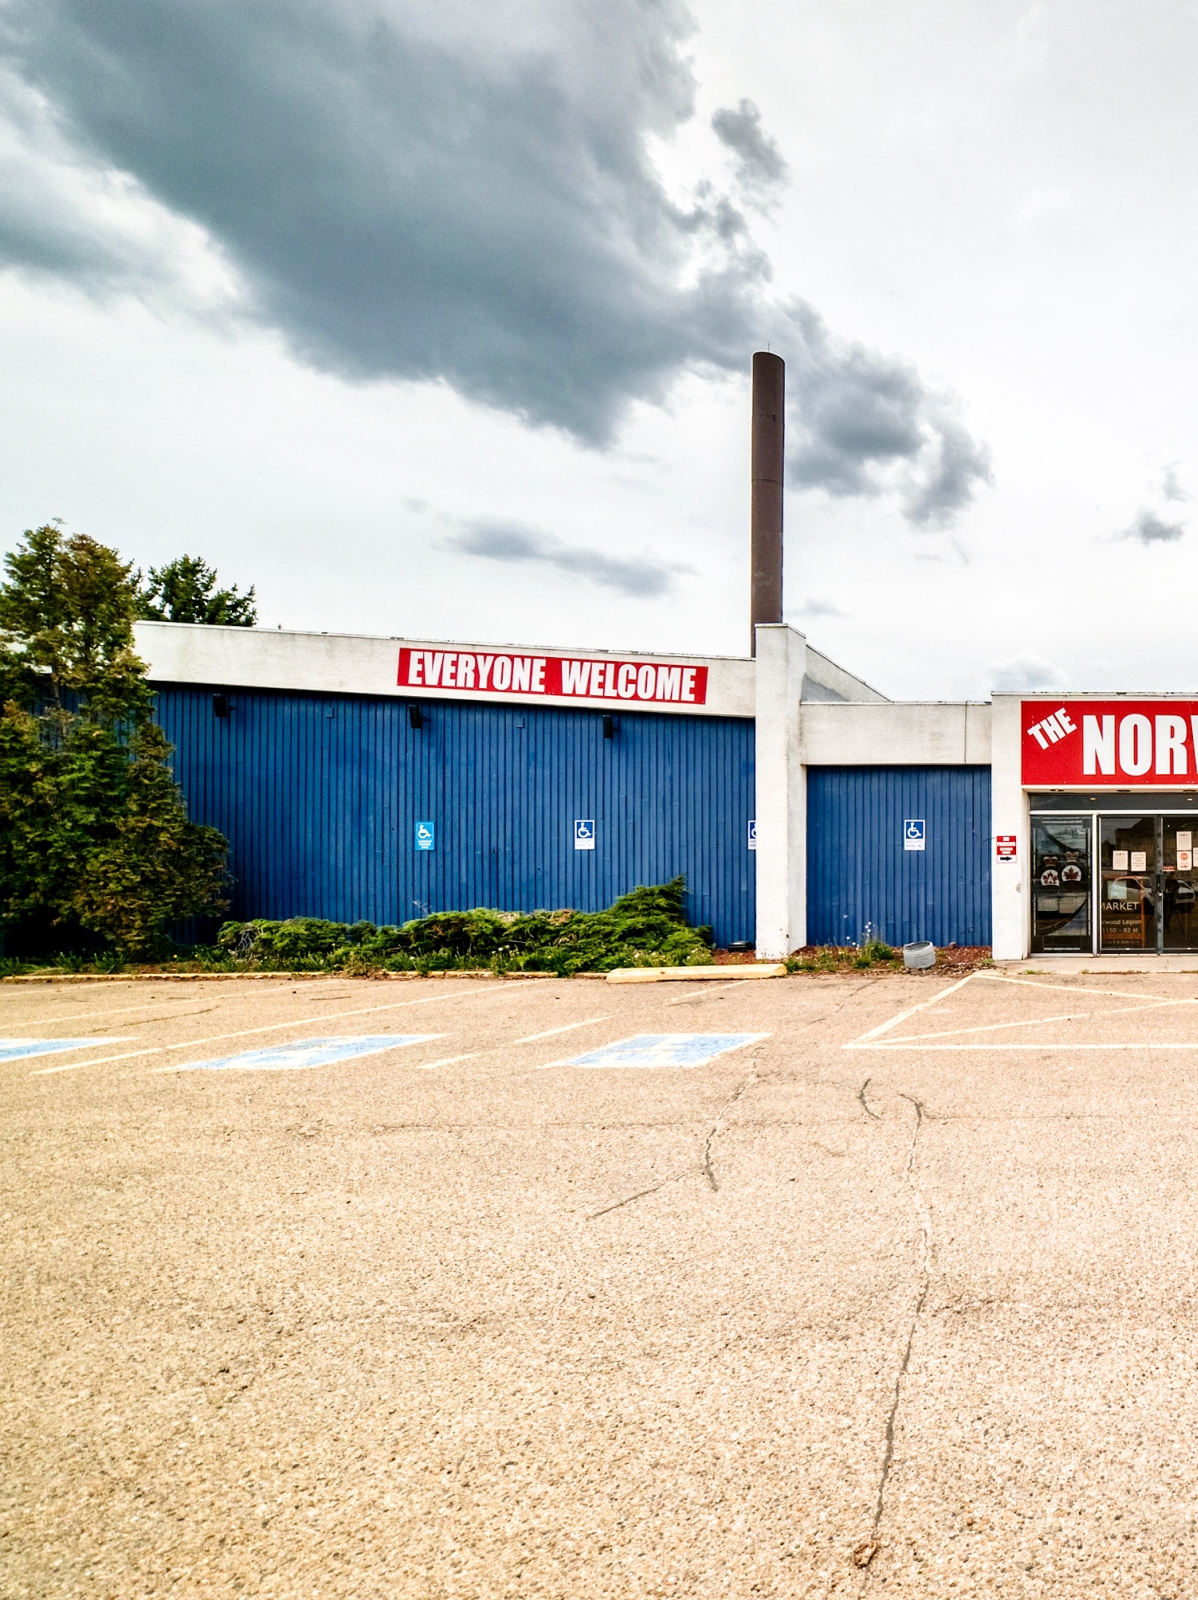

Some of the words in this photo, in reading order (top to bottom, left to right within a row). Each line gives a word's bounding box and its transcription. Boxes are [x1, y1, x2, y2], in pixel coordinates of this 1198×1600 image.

[408, 651, 546, 692] EVERYONE
[561, 660, 697, 701] WELCOME
[1027, 707, 1077, 750] THE
